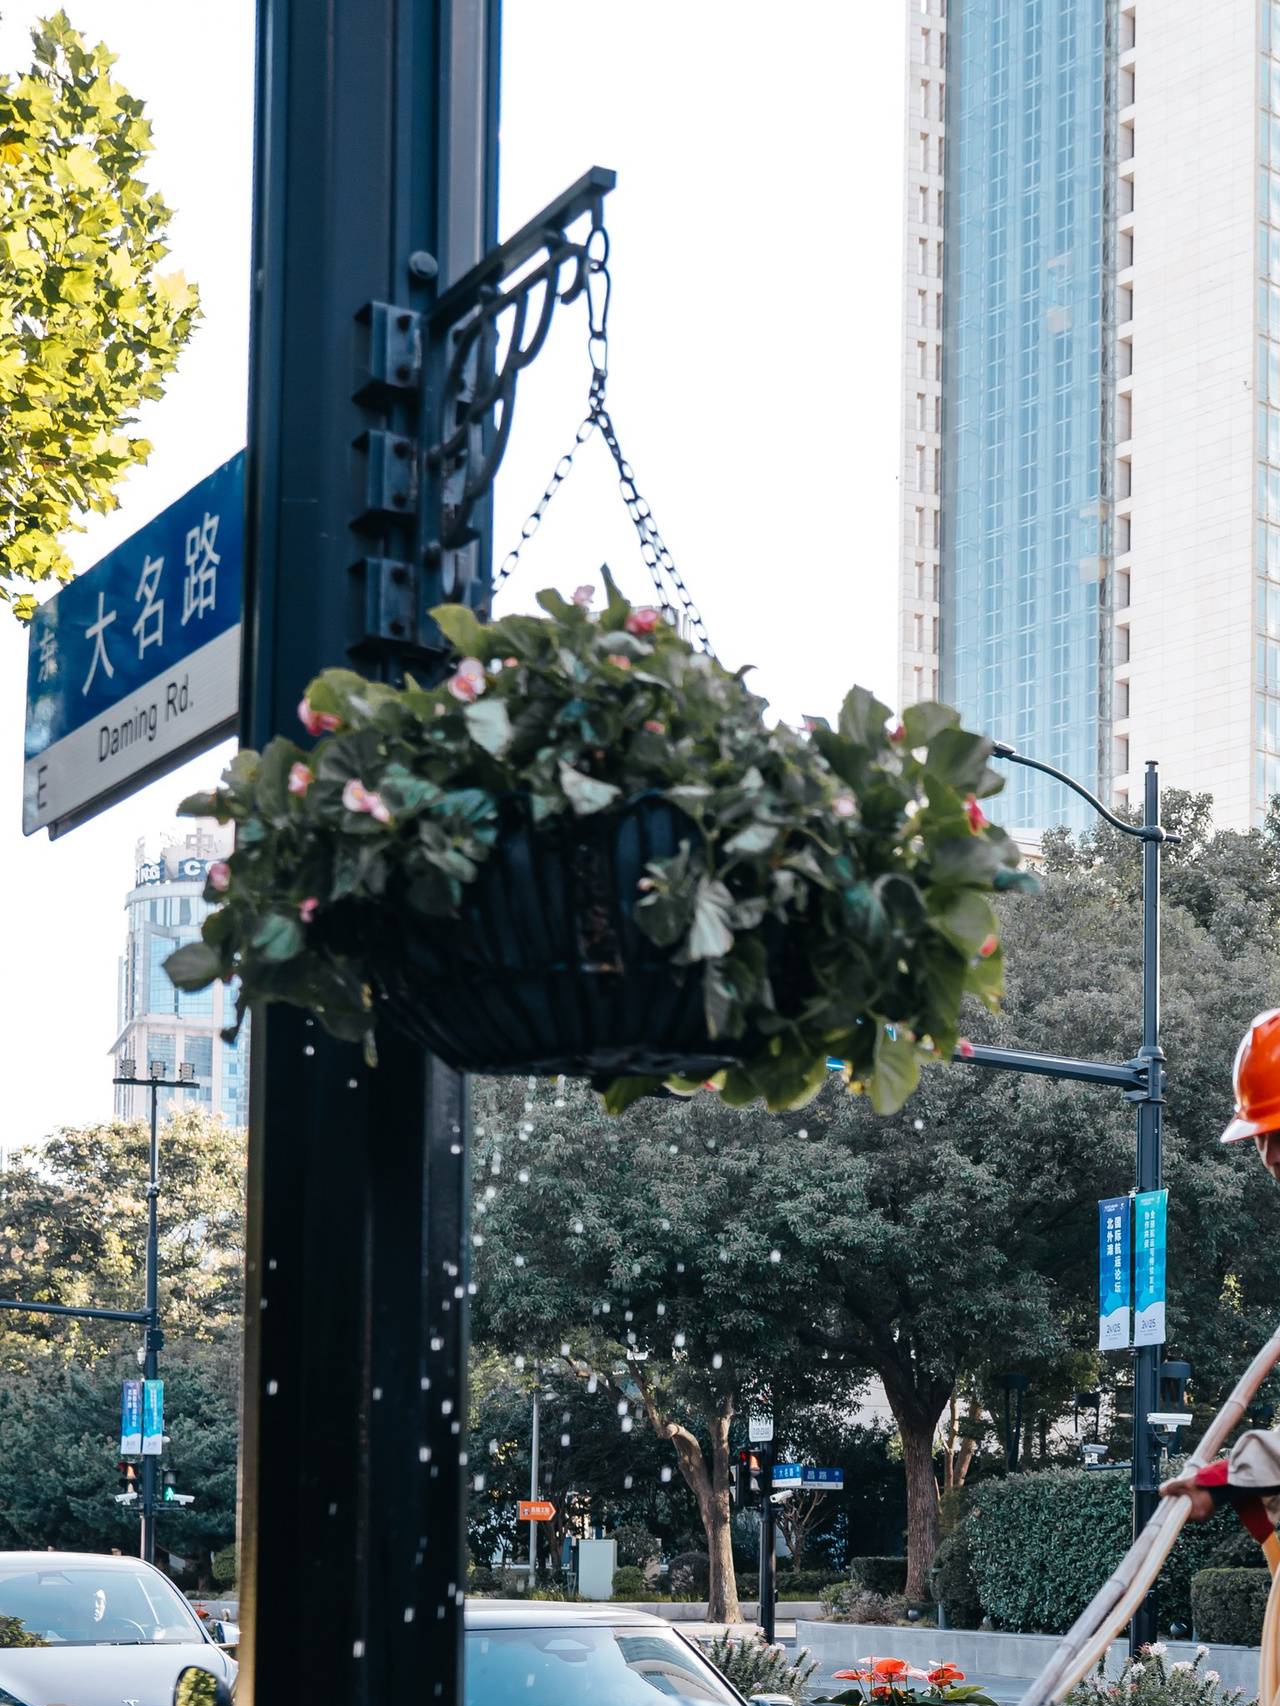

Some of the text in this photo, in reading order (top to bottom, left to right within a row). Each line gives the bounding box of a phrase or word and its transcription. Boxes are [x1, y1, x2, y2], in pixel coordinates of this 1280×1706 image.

[81, 511, 221, 696] 大名路
[99, 674, 194, 763] Daming Rd.
[36, 765, 48, 811] E
